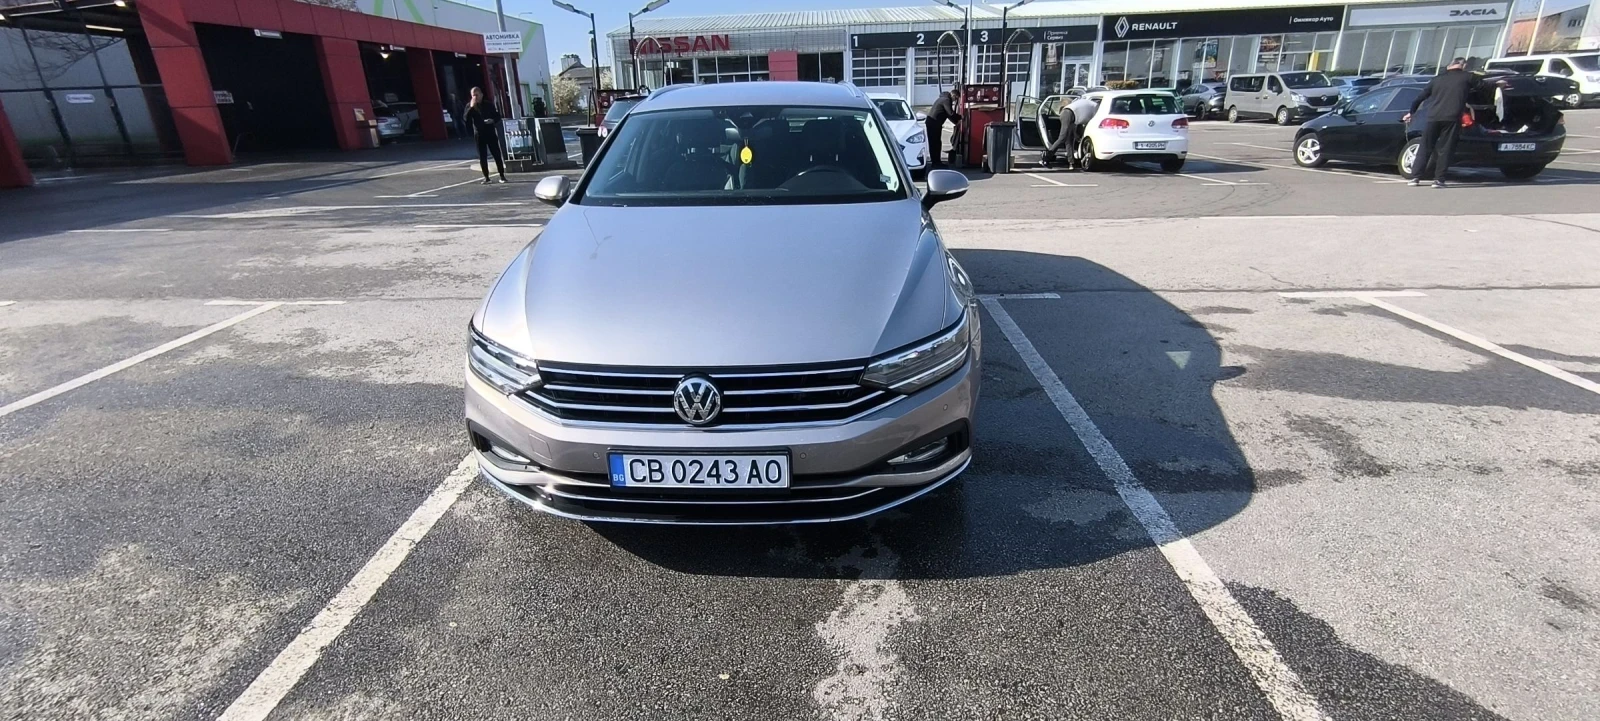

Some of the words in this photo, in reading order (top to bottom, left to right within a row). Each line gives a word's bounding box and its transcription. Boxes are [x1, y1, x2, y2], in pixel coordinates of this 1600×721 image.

[1449, 8, 1498, 17] DACIA
[1131, 21, 1178, 32] RENAULT
[852, 35, 859, 47] 1
[916, 33, 925, 45] 2
[979, 30, 989, 43] 3
[628, 34, 730, 55] NISSAN
[612, 473, 625, 482] BG
[629, 458, 665, 484] CB
[671, 459, 739, 484] 0243
[746, 459, 782, 484] AO
